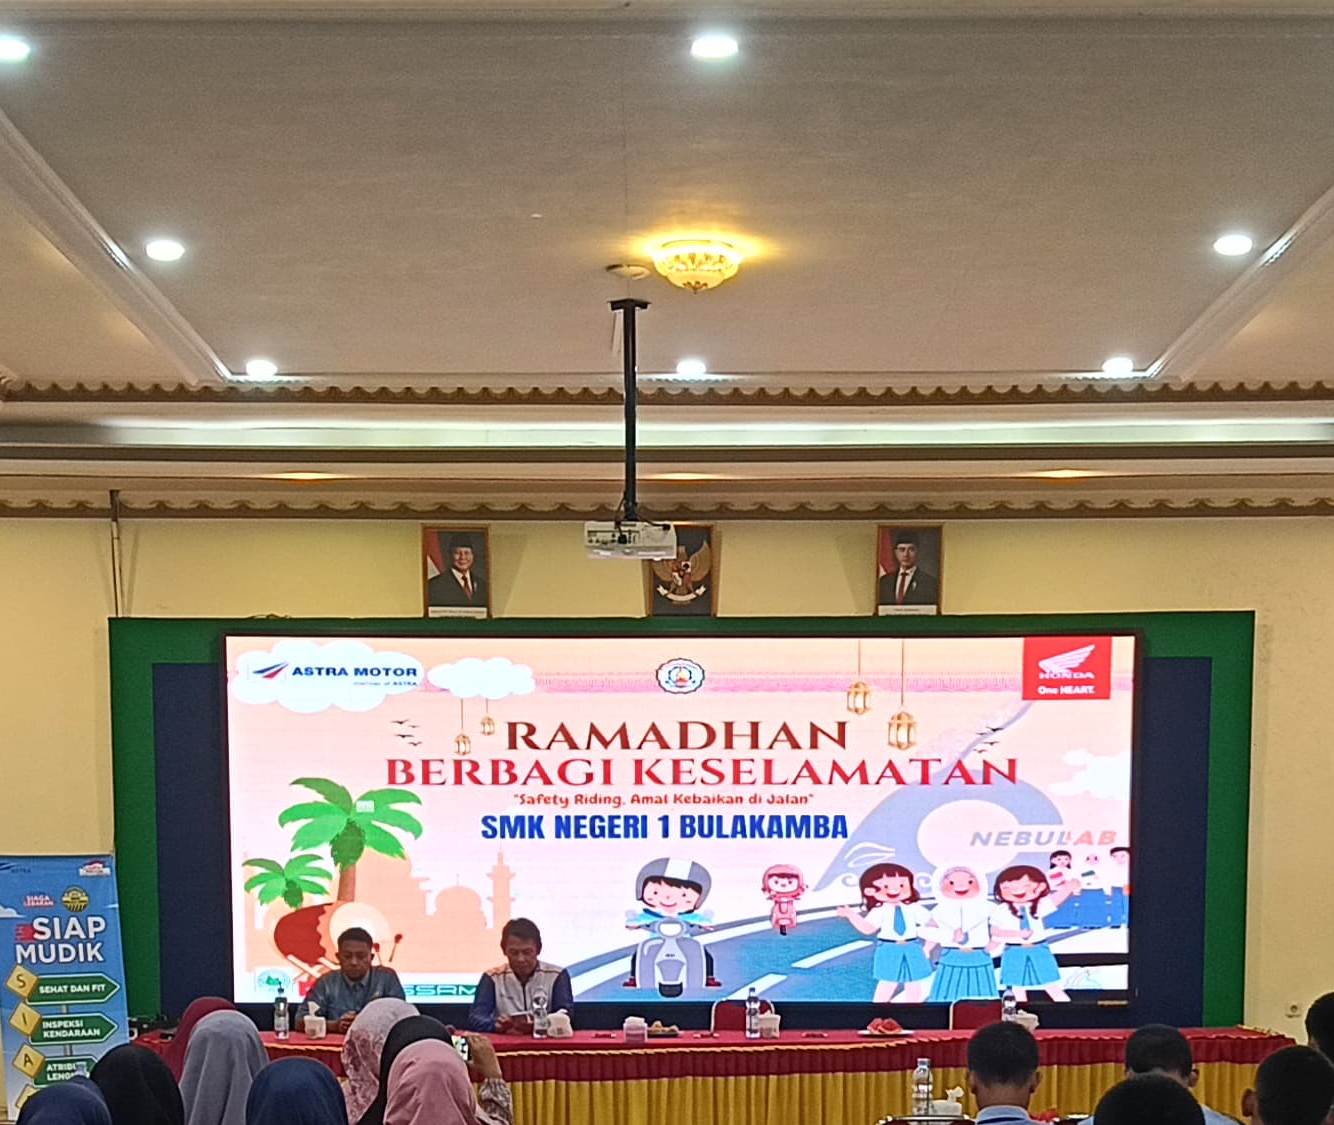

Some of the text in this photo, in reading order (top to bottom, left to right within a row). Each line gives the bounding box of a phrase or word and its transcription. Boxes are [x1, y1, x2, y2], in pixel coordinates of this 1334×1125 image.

[292, 667, 417, 676] ASTRA MOTOR
[1039, 671, 1095, 680] HONDA
[1038, 685, 1058, 695] One
[507, 721, 849, 750] RAMADHAN
[386, 758, 1017, 786] BERBAGI KESELAMATAN
[631, 794, 668, 805] Amal
[673, 793, 744, 805] Kebaikan
[748, 793, 763, 805] di
[481, 815, 849, 839] SMK NEGERI 1 BULAKAMBA
[970, 829, 1117, 847] NEBULAB
[33, 916, 106, 940] SIAP
[15, 942, 105, 964] MUDIK
[16, 973, 27, 989] S
[39, 983, 106, 994] SEHAT DAN FIT
[21, 1013, 28, 1026] I
[42, 1020, 83, 1029] INSPEKSI
[43, 1027, 101, 1038] KENDARAAN
[23, 1053, 34, 1067] A
